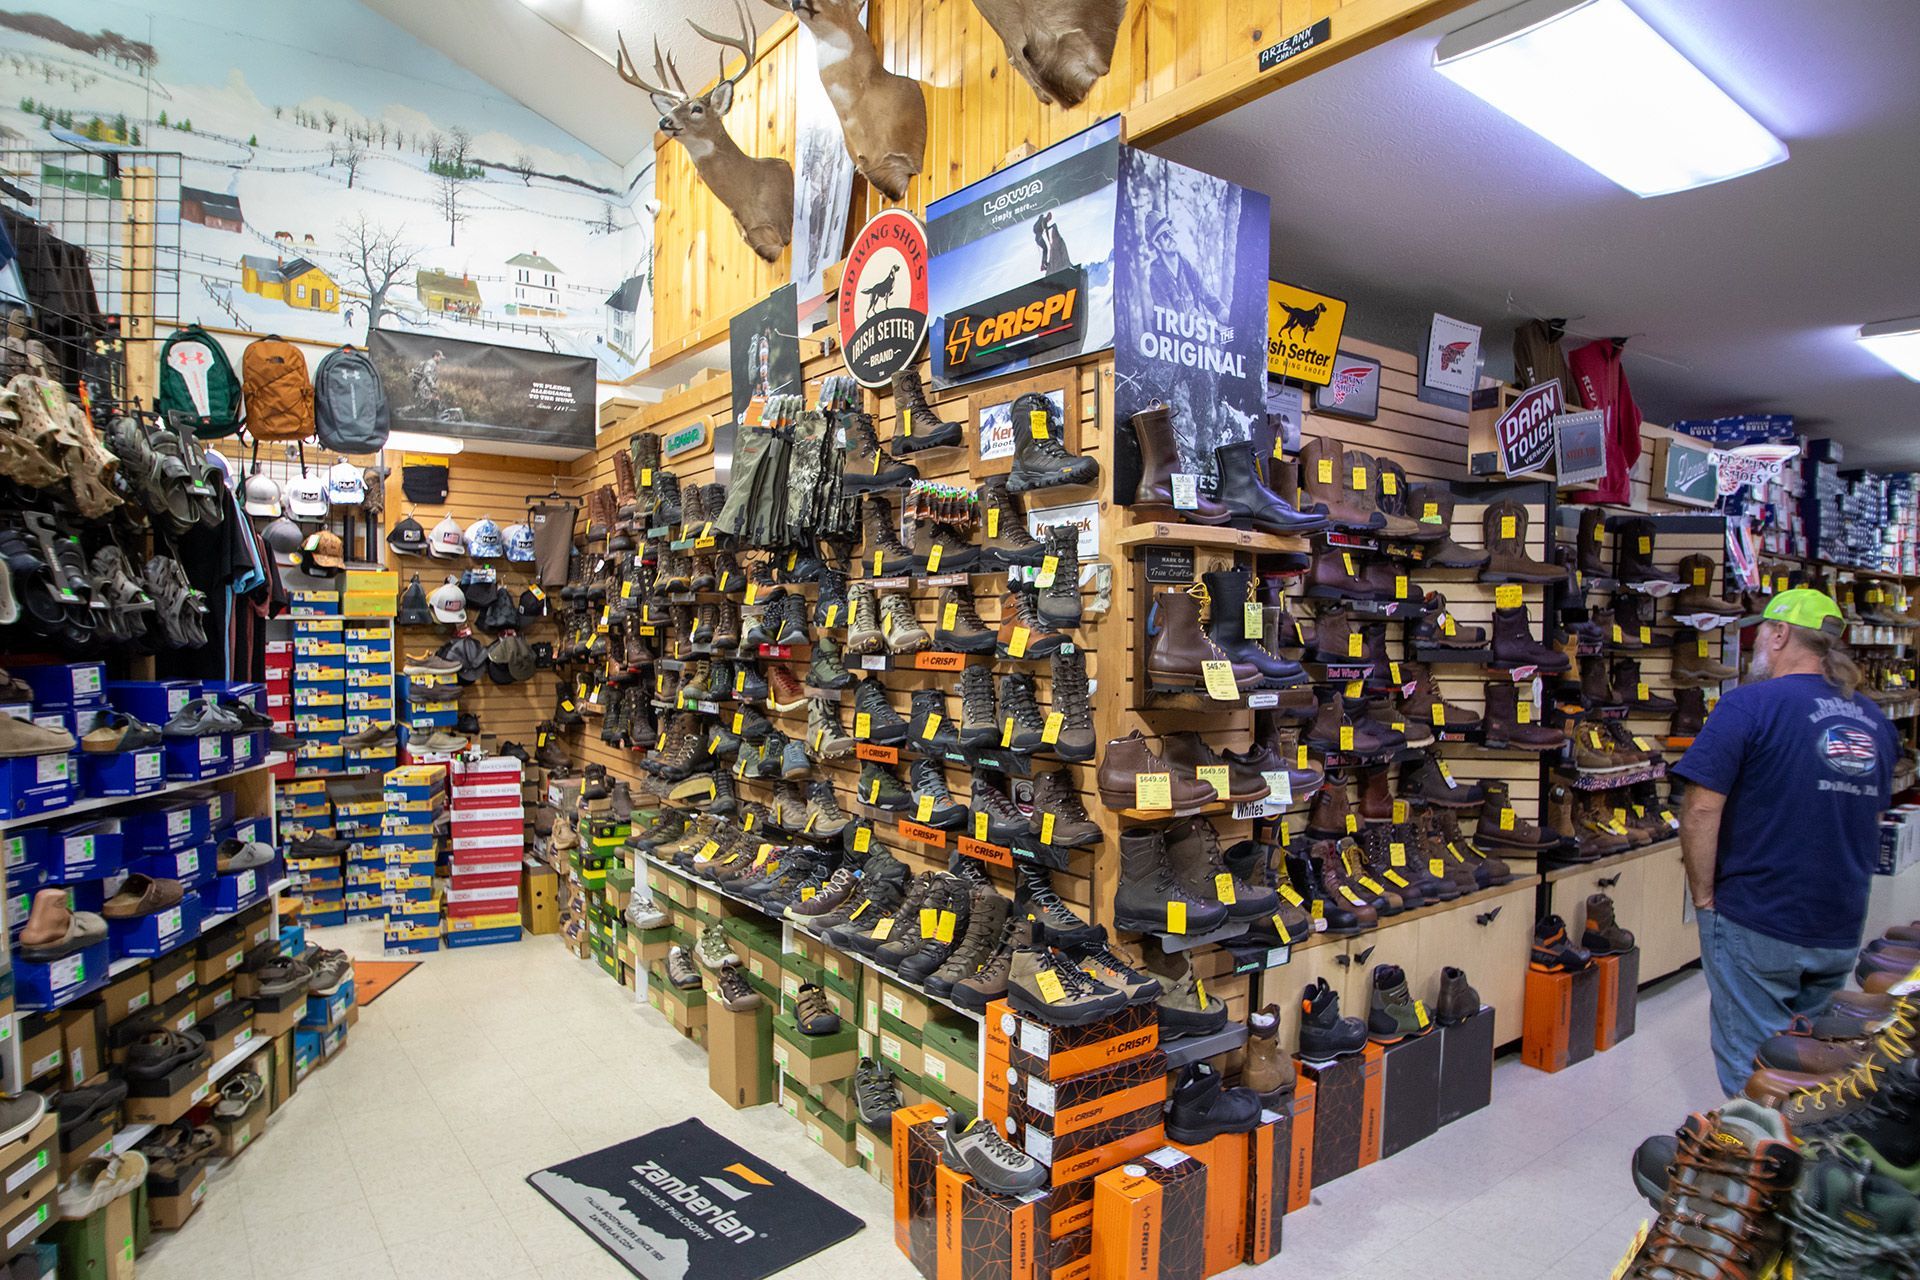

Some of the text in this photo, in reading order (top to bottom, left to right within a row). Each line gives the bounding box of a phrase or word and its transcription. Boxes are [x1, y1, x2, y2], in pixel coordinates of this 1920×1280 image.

[1292, 26, 1312, 46] ANN
[1303, 37, 1314, 50] ON
[983, 179, 1043, 216] LOWA
[992, 209, 1013, 225] simply
[843, 223, 926, 313] RED WING SHOES
[975, 287, 1077, 347] CRISPI
[1153, 305, 1234, 344] TRUST THE
[852, 318, 915, 364] IRISH SETTER
[870, 349, 894, 367] BRAND
[1140, 331, 1246, 379] ORIGINAL
[1288, 343, 1331, 368] Setter
[1304, 366, 1326, 377] SHOES
[530, 388, 573, 398] ALLEGIANCE
[544, 383, 571, 392] PLEDGE
[555, 396, 576, 404] HUNT.
[1505, 387, 1555, 445] DARN
[667, 427, 700, 453] LOWA
[1524, 437, 1554, 465] VERMONT
[1724, 468, 1763, 484] SHOES
[930, 657, 958, 666] CRISPI
[1328, 667, 1361, 679] Red Wings
[869, 749, 892, 759] CRISPI
[945, 752, 965, 761] LOWA
[978, 757, 1000, 767] LOWA
[1139, 775, 1168, 783] $649.50
[1200, 767, 1227, 775] $649.50
[1236, 803, 1264, 819] Whites
[912, 828, 938, 841] CRISPI
[973, 845, 1004, 860] CRISPI
[1012, 847, 1035, 858] LOWA
[1237, 962, 1260, 973] LOWA
[987, 1034, 1008, 1047] CRISPI
[1117, 1035, 1152, 1053] CRISPI
[985, 1081, 1005, 1095] CRISPI
[1075, 1107, 1104, 1123] CRISPI
[1072, 1157, 1100, 1174] CRISPI
[1122, 1179, 1146, 1191] CRISPI
[631, 1160, 756, 1244] zamberlan
[630, 1180, 715, 1242] HANDMADE PHILOSOPHY
[601, 1207, 637, 1240] BOOTMAKERS
[635, 1233, 654, 1252] SINCE
[945, 1199, 953, 1250] CRISPI
[1259, 1208, 1267, 1252] CRISPI
[589, 1214, 635, 1252] ZAMBERLAN.COM
[1141, 1222, 1149, 1272] CRISPI
